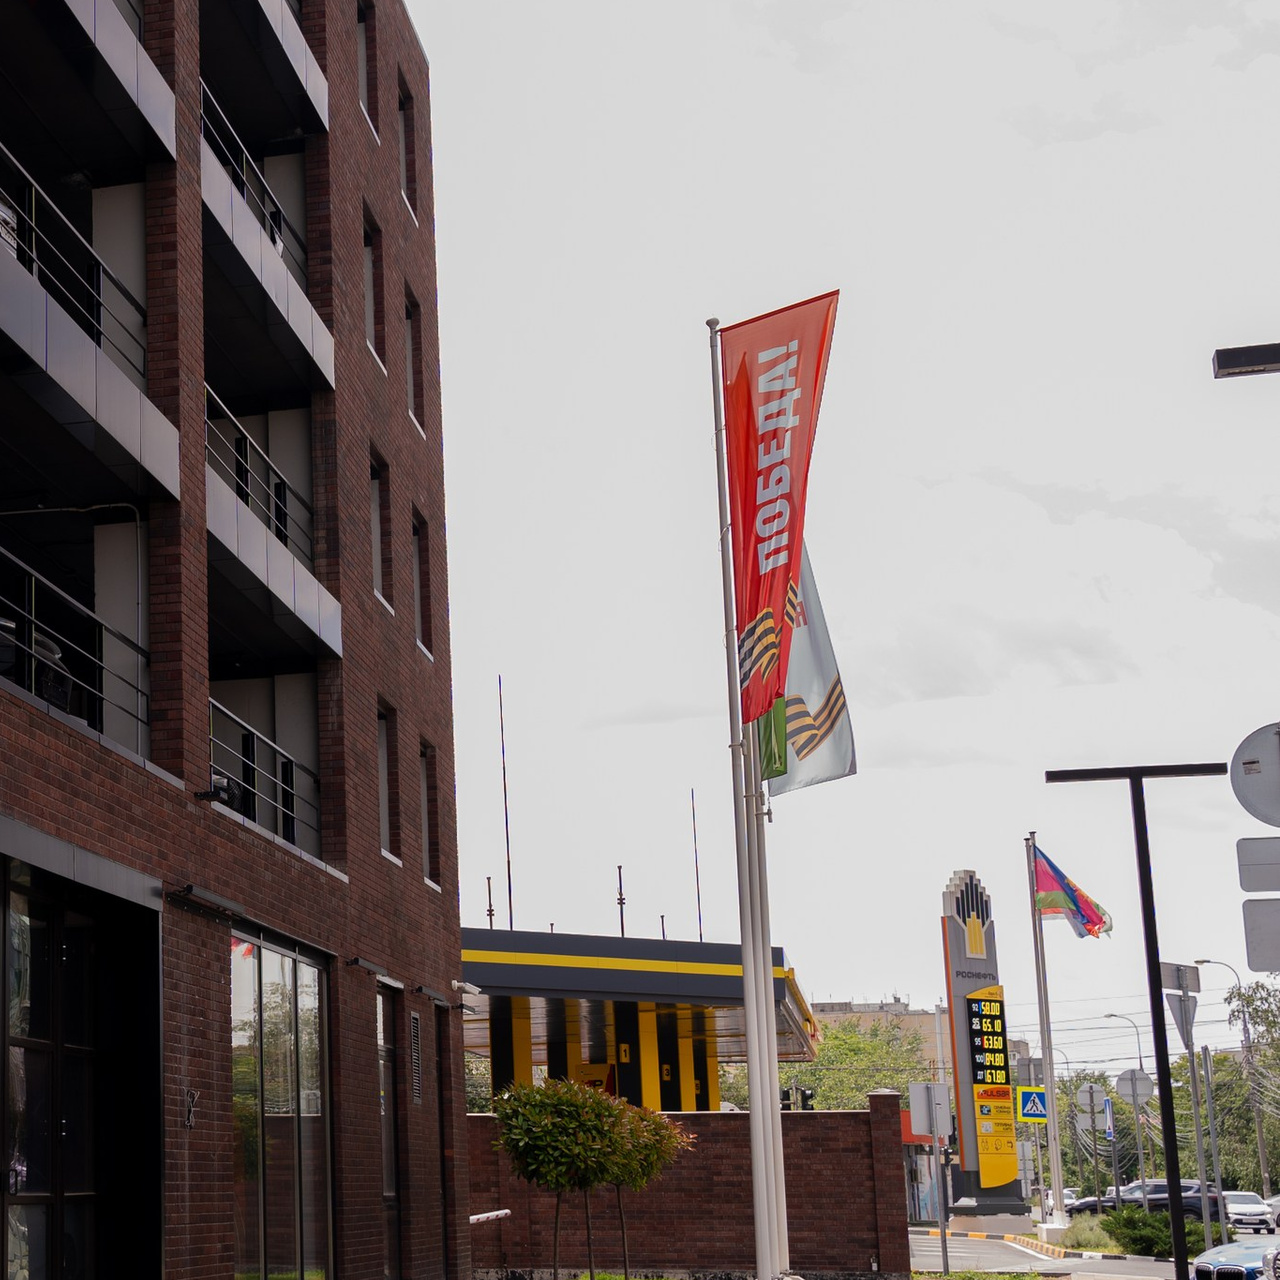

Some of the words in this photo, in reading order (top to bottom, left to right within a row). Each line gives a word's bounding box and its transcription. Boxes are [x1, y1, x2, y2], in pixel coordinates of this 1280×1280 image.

[756, 338, 801, 577] ПОБЕДА!
[955, 970, 996, 981] РОСНЕФТЬ
[971, 1003, 979, 1012] 92
[981, 1001, 1000, 1015] 58.00
[982, 1018, 1002, 1032] 65.10
[974, 1037, 981, 1046] 95
[984, 1035, 1003, 1049] 63.60
[975, 1055, 984, 1063] 100
